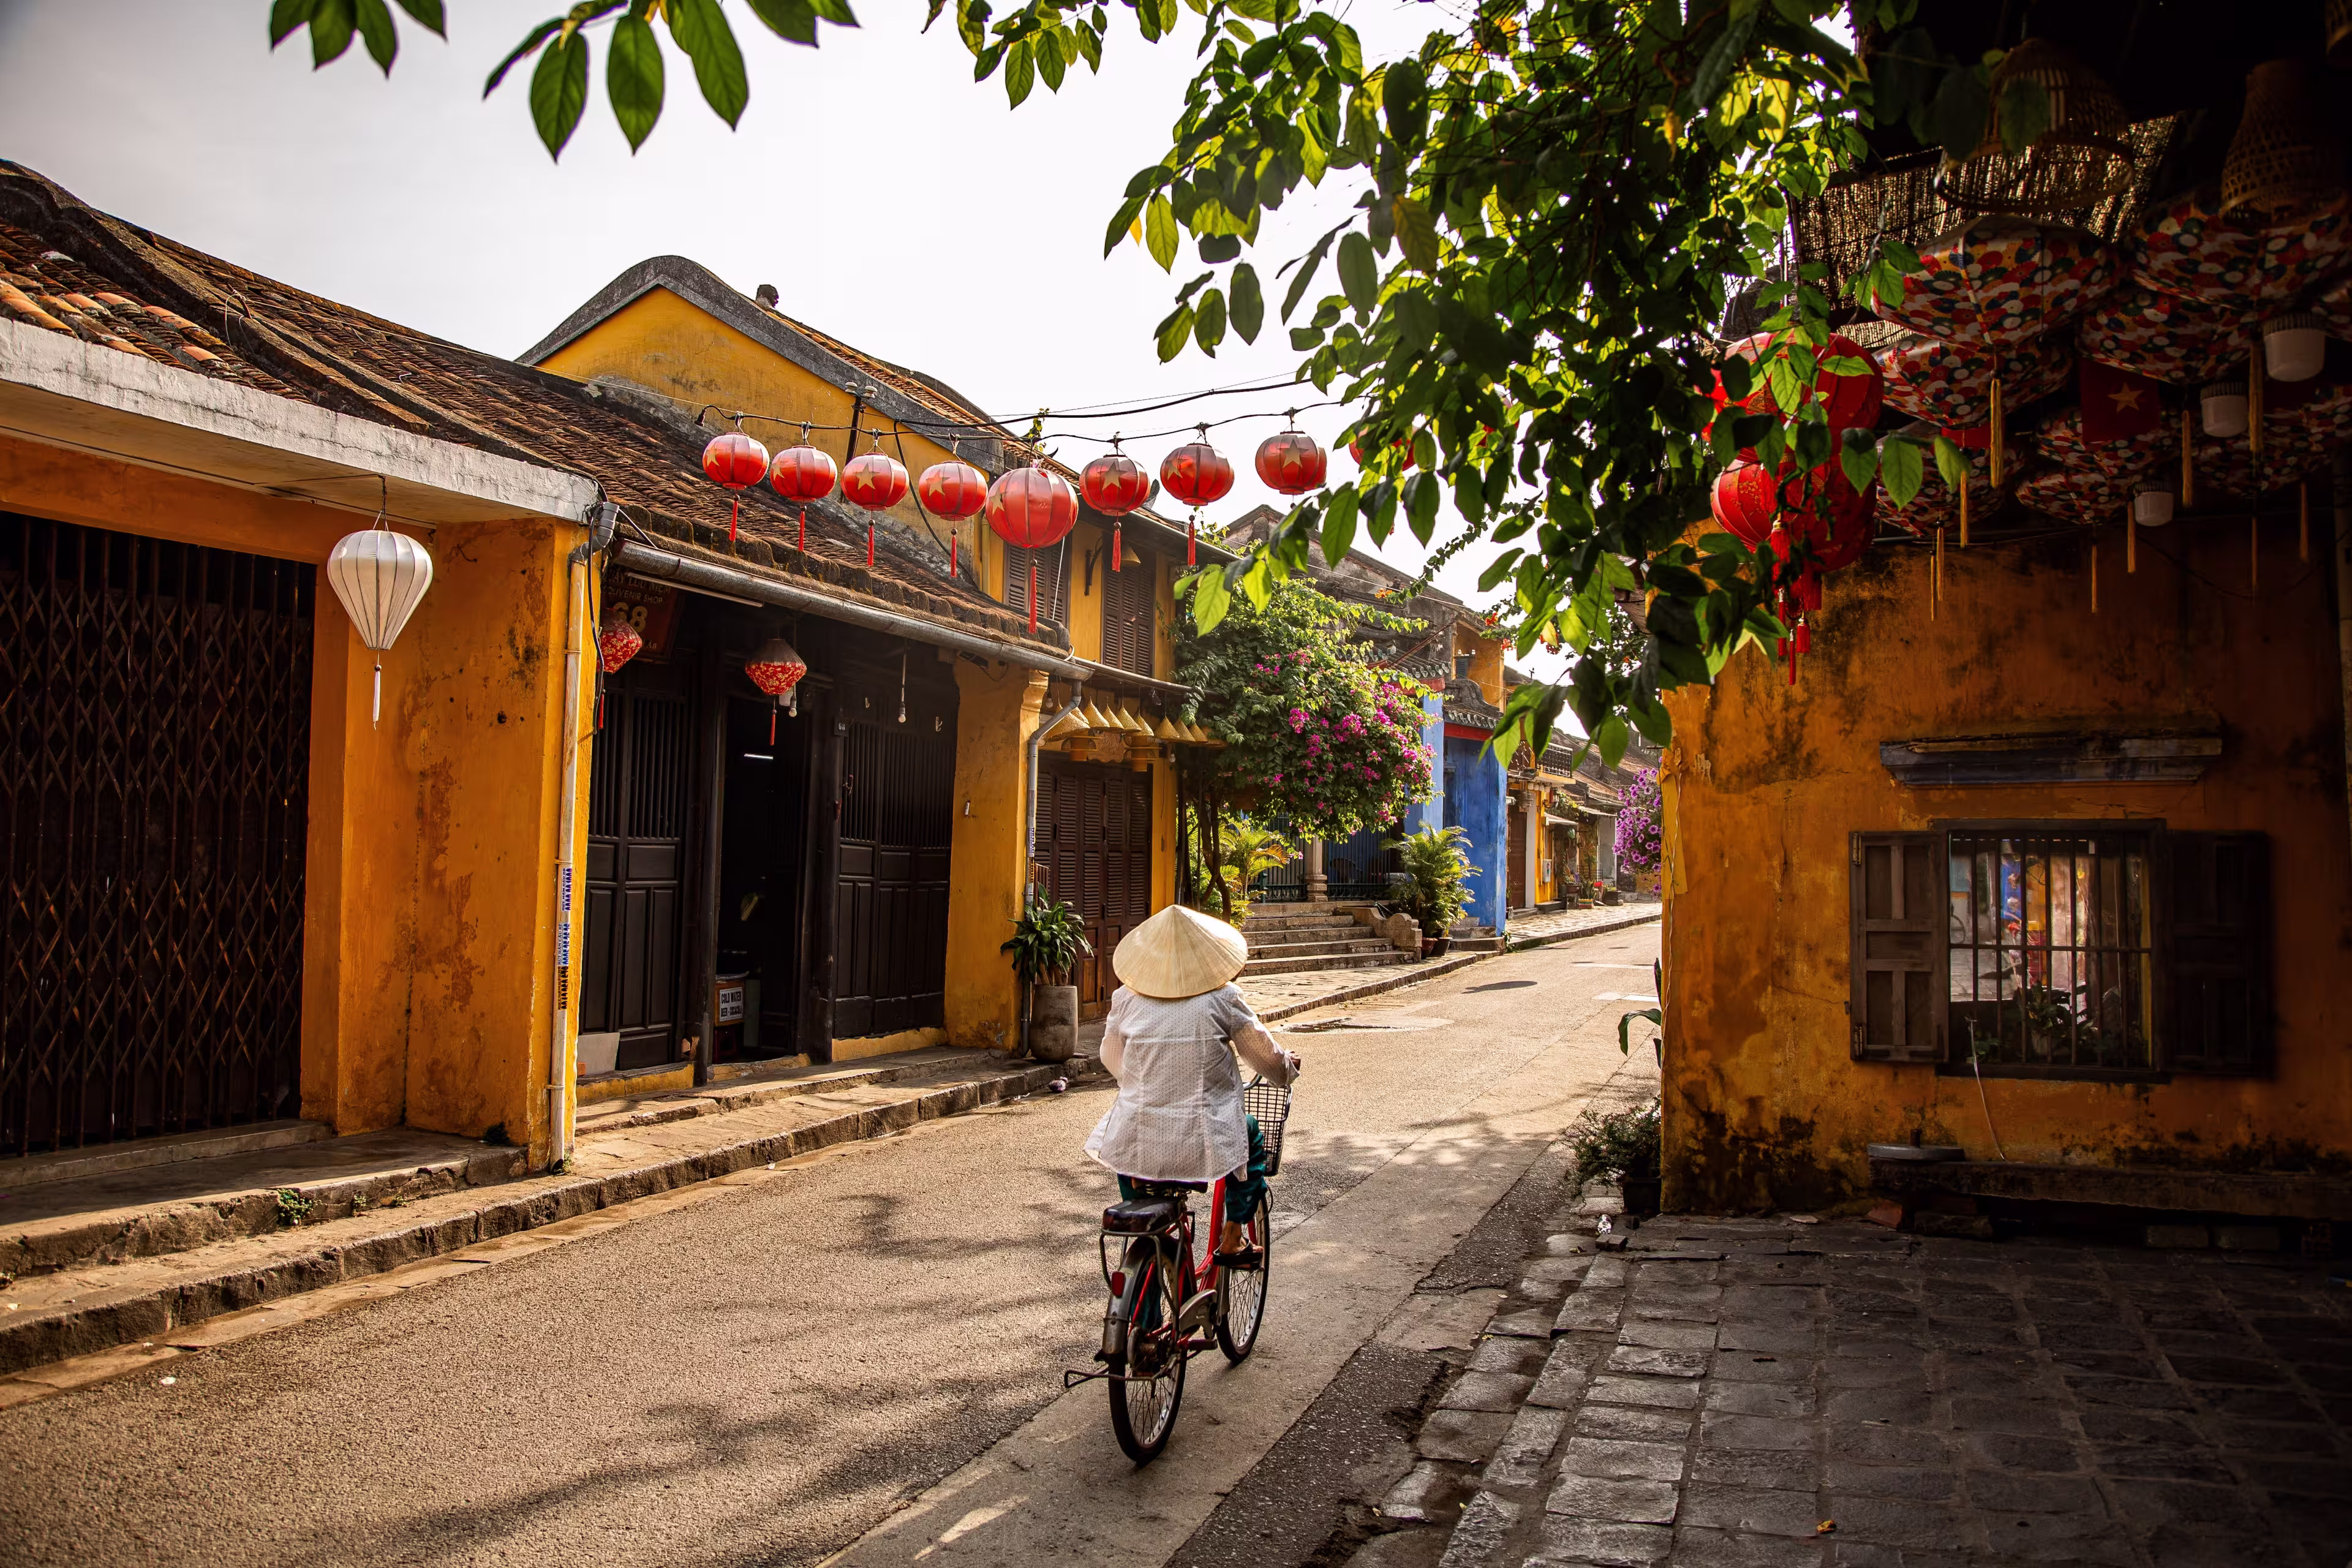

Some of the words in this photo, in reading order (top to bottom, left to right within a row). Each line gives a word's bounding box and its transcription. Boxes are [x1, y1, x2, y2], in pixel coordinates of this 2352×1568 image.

[643, 594, 663, 603] SHOP
[731, 991, 742, 1003] WATER
[729, 1005, 742, 1016] COCACOLA
